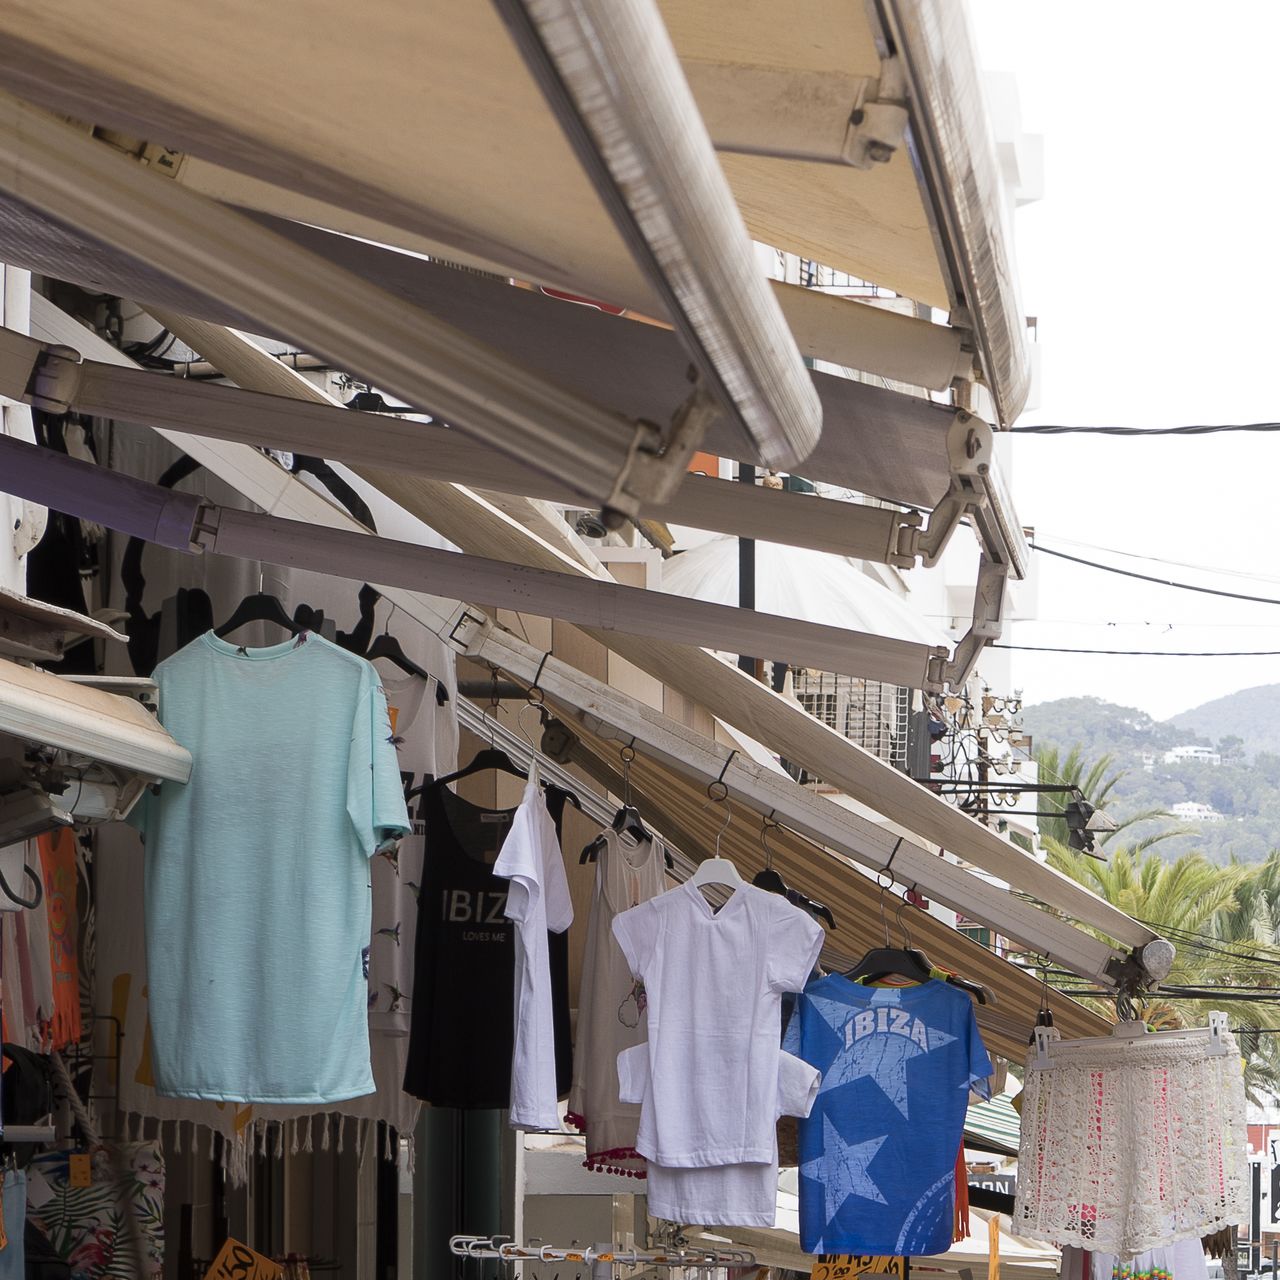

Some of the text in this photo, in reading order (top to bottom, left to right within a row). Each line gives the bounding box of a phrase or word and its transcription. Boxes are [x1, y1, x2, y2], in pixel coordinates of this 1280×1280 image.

[442, 890, 514, 925] IBIZ
[463, 931, 506, 943] LOVES ME
[845, 1007, 929, 1054] IBIZA
